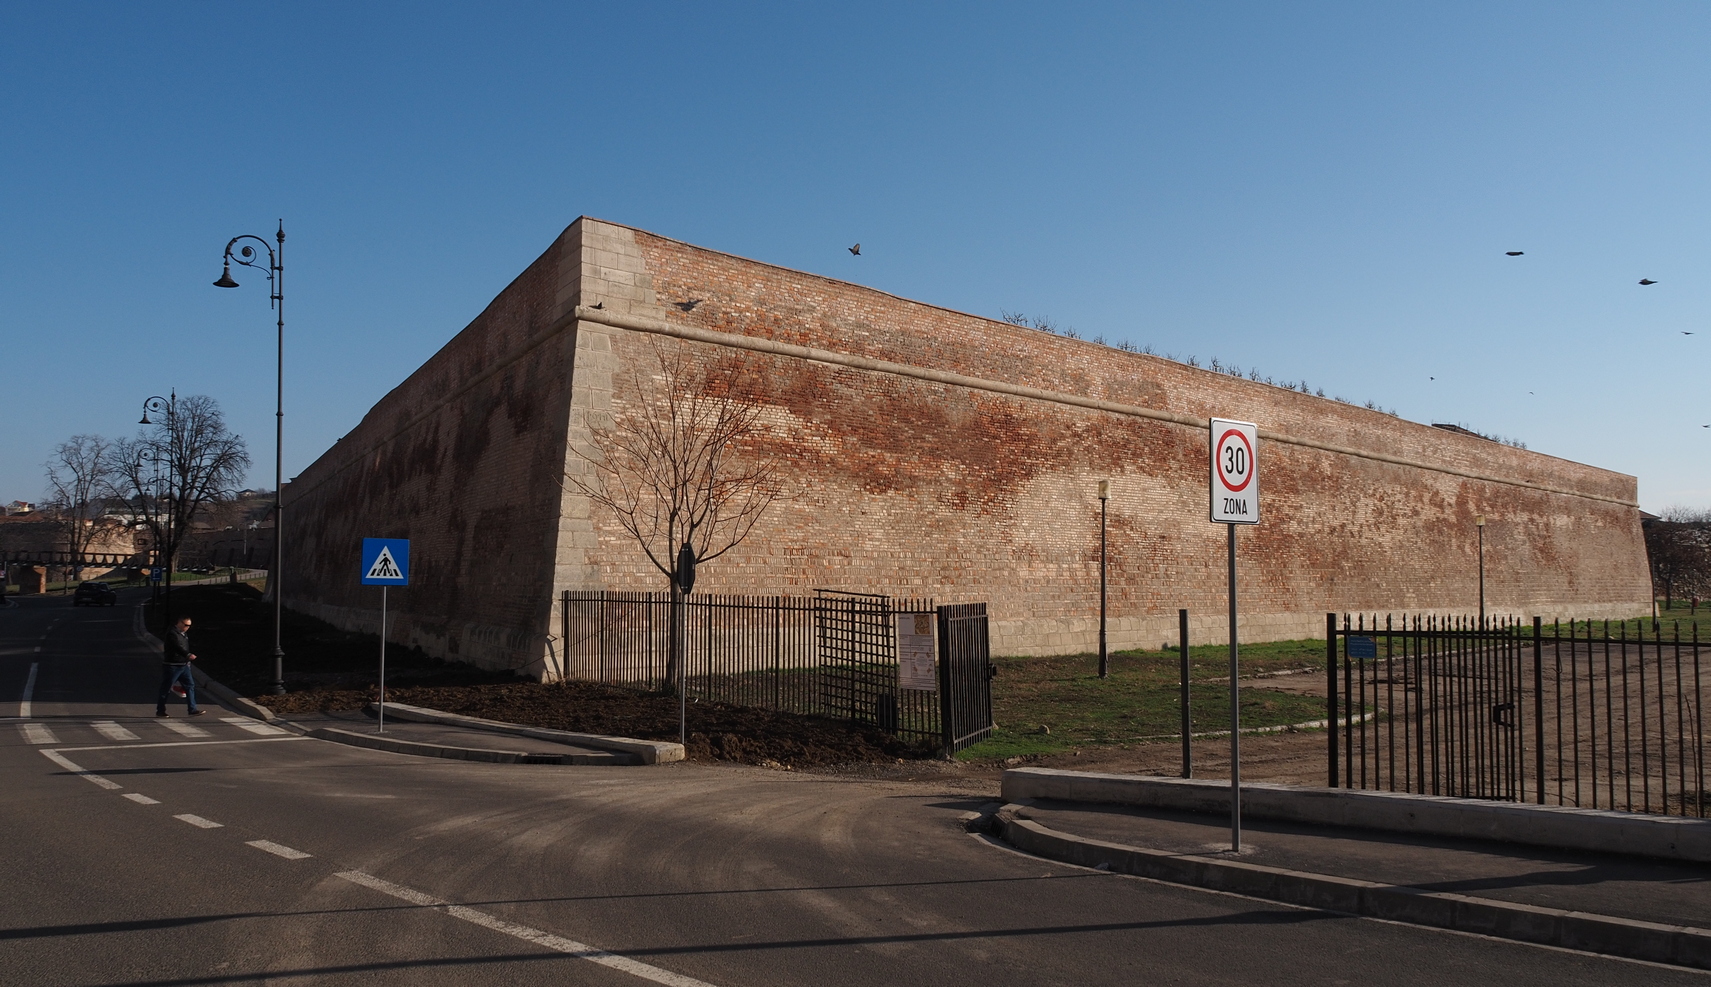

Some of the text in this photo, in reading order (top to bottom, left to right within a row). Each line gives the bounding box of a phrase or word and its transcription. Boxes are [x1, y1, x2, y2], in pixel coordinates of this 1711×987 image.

[1225, 446, 1244, 475] 30
[1223, 498, 1248, 515] ZONA
[152, 568, 160, 577] P
